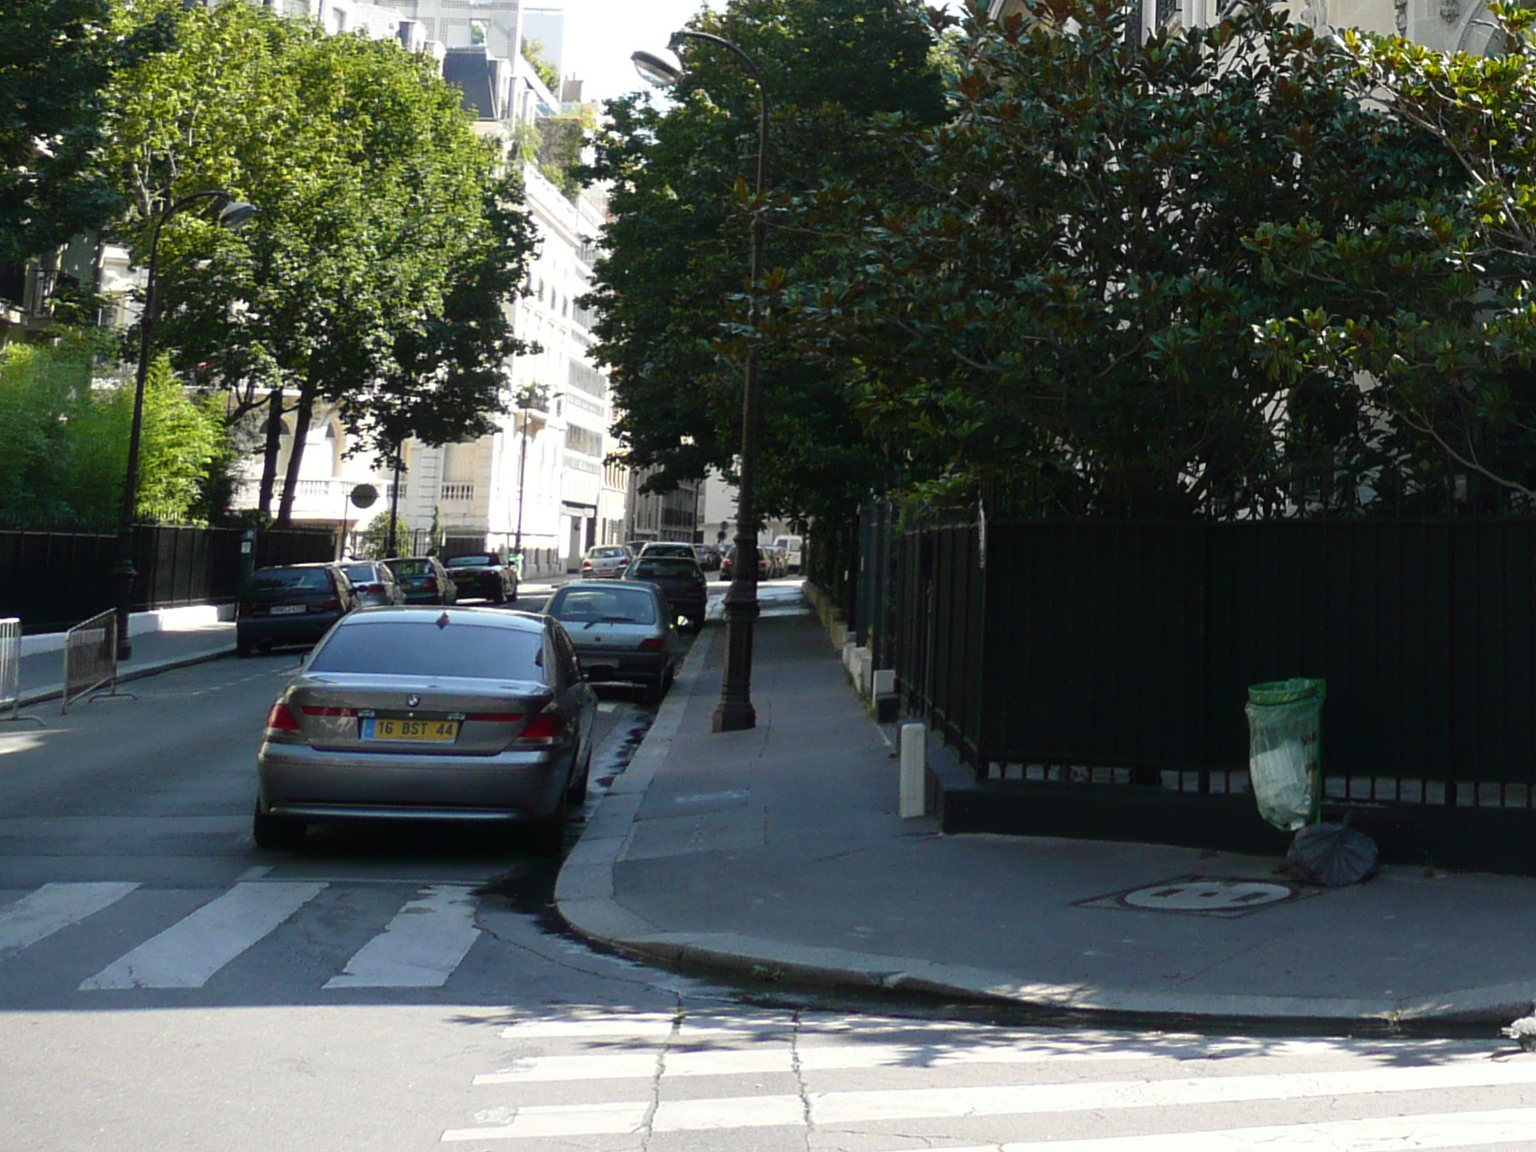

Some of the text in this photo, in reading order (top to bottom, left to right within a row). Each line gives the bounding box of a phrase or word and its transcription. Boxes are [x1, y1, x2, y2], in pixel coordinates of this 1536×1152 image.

[378, 721, 453, 736] 16 BST 44
